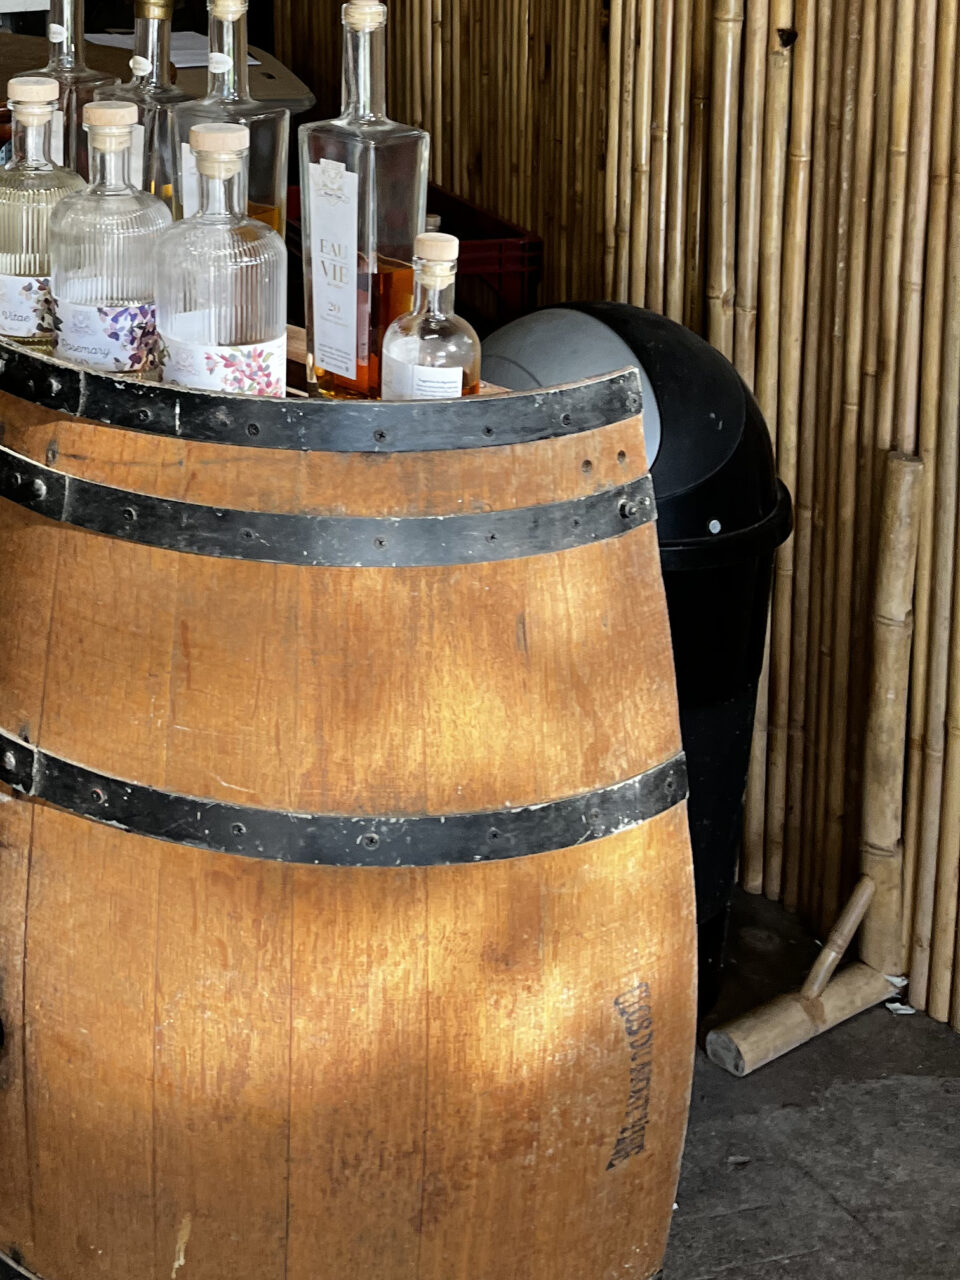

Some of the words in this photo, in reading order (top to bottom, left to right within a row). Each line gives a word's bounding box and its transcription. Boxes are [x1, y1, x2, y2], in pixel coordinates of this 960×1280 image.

[319, 238, 349, 260] EAU
[320, 259, 350, 285] VIE
[1, 310, 31, 322] Vitae
[60, 339, 111, 359] Rosemary
